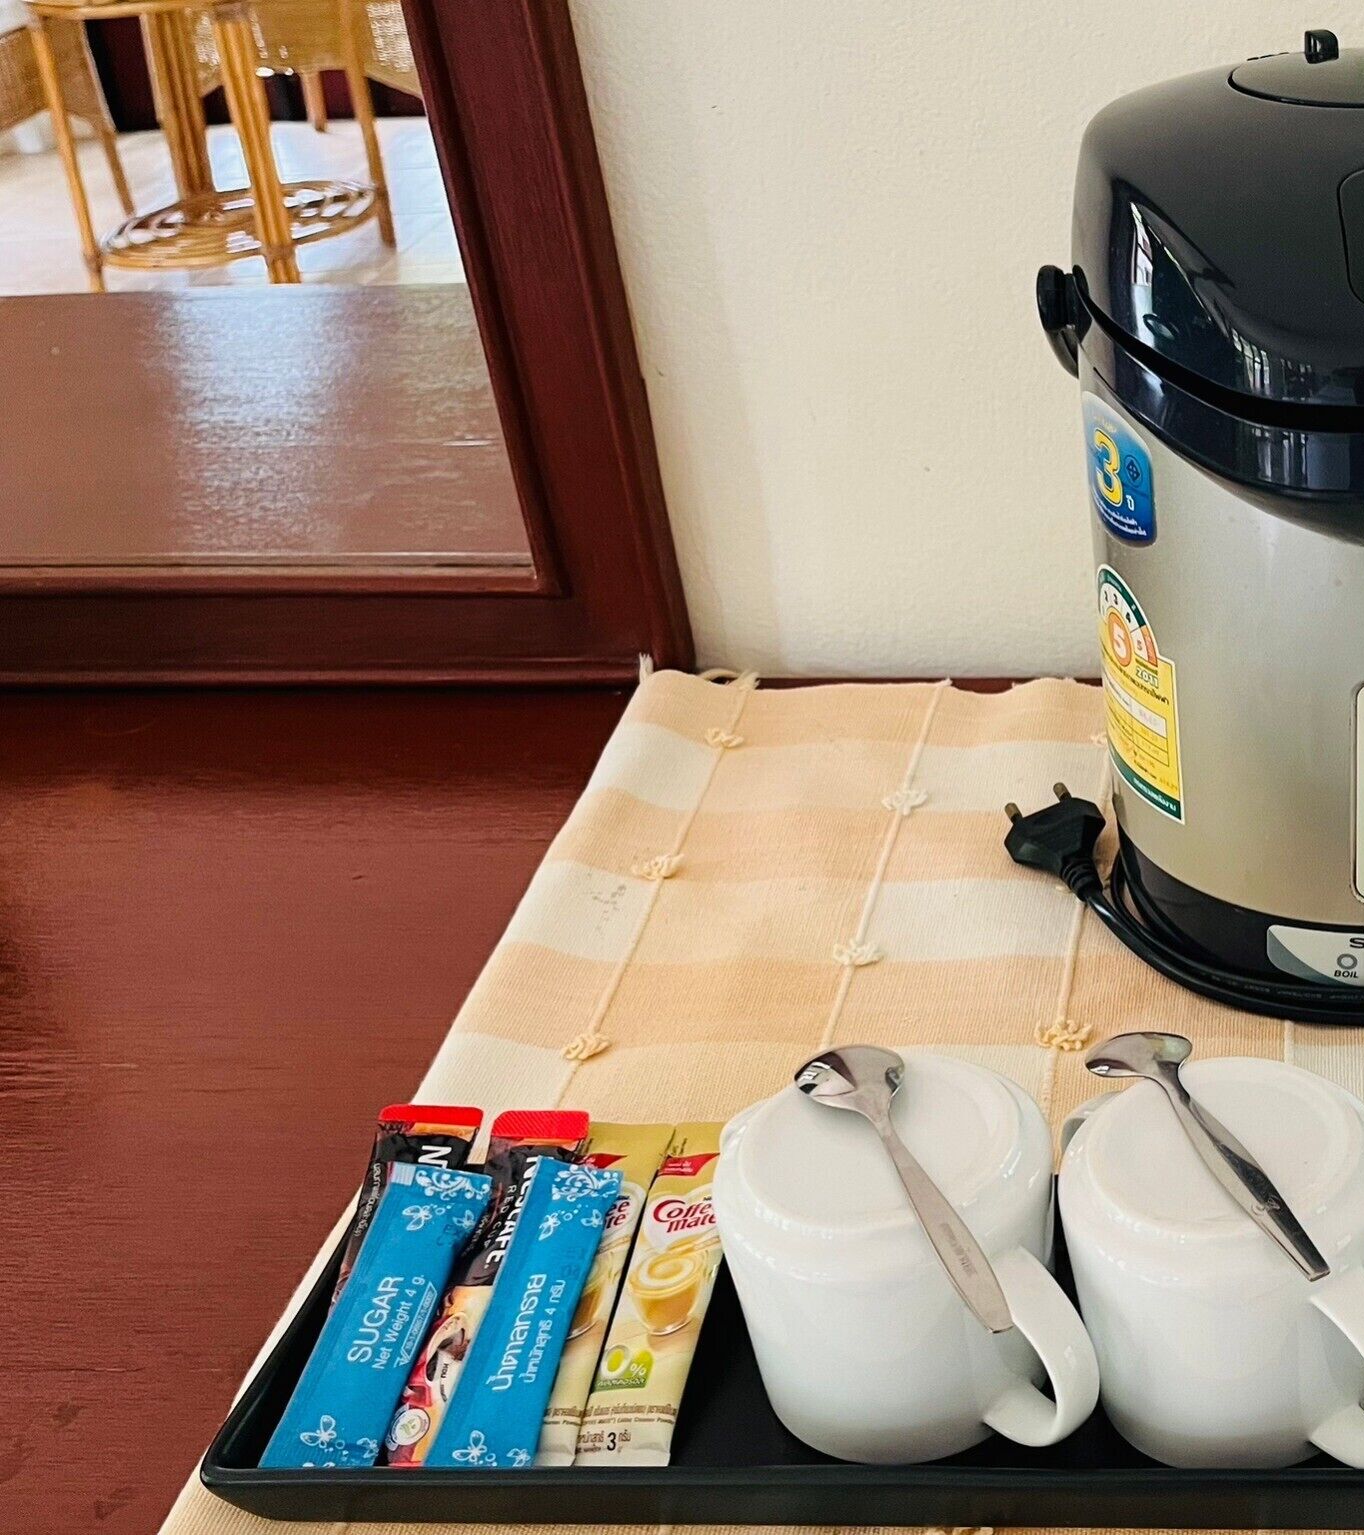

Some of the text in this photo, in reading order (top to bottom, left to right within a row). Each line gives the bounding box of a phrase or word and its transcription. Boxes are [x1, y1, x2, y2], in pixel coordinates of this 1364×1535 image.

[1093, 427, 1124, 508] 3
[1334, 970, 1359, 979] BOIL
[500, 1184, 518, 1214] RED
[653, 1199, 713, 1223] Coffe
[549, 1279, 567, 1303] กรัม
[347, 1276, 404, 1363] SUGAR
[544, 1308, 556, 1316] 4
[371, 1347, 393, 1370] Net
[383, 1300, 414, 1343] Weight
[405, 1289, 417, 1297] 4
[486, 1273, 548, 1392] น้ำตาลทราย
[606, 1432, 617, 1452] 3
